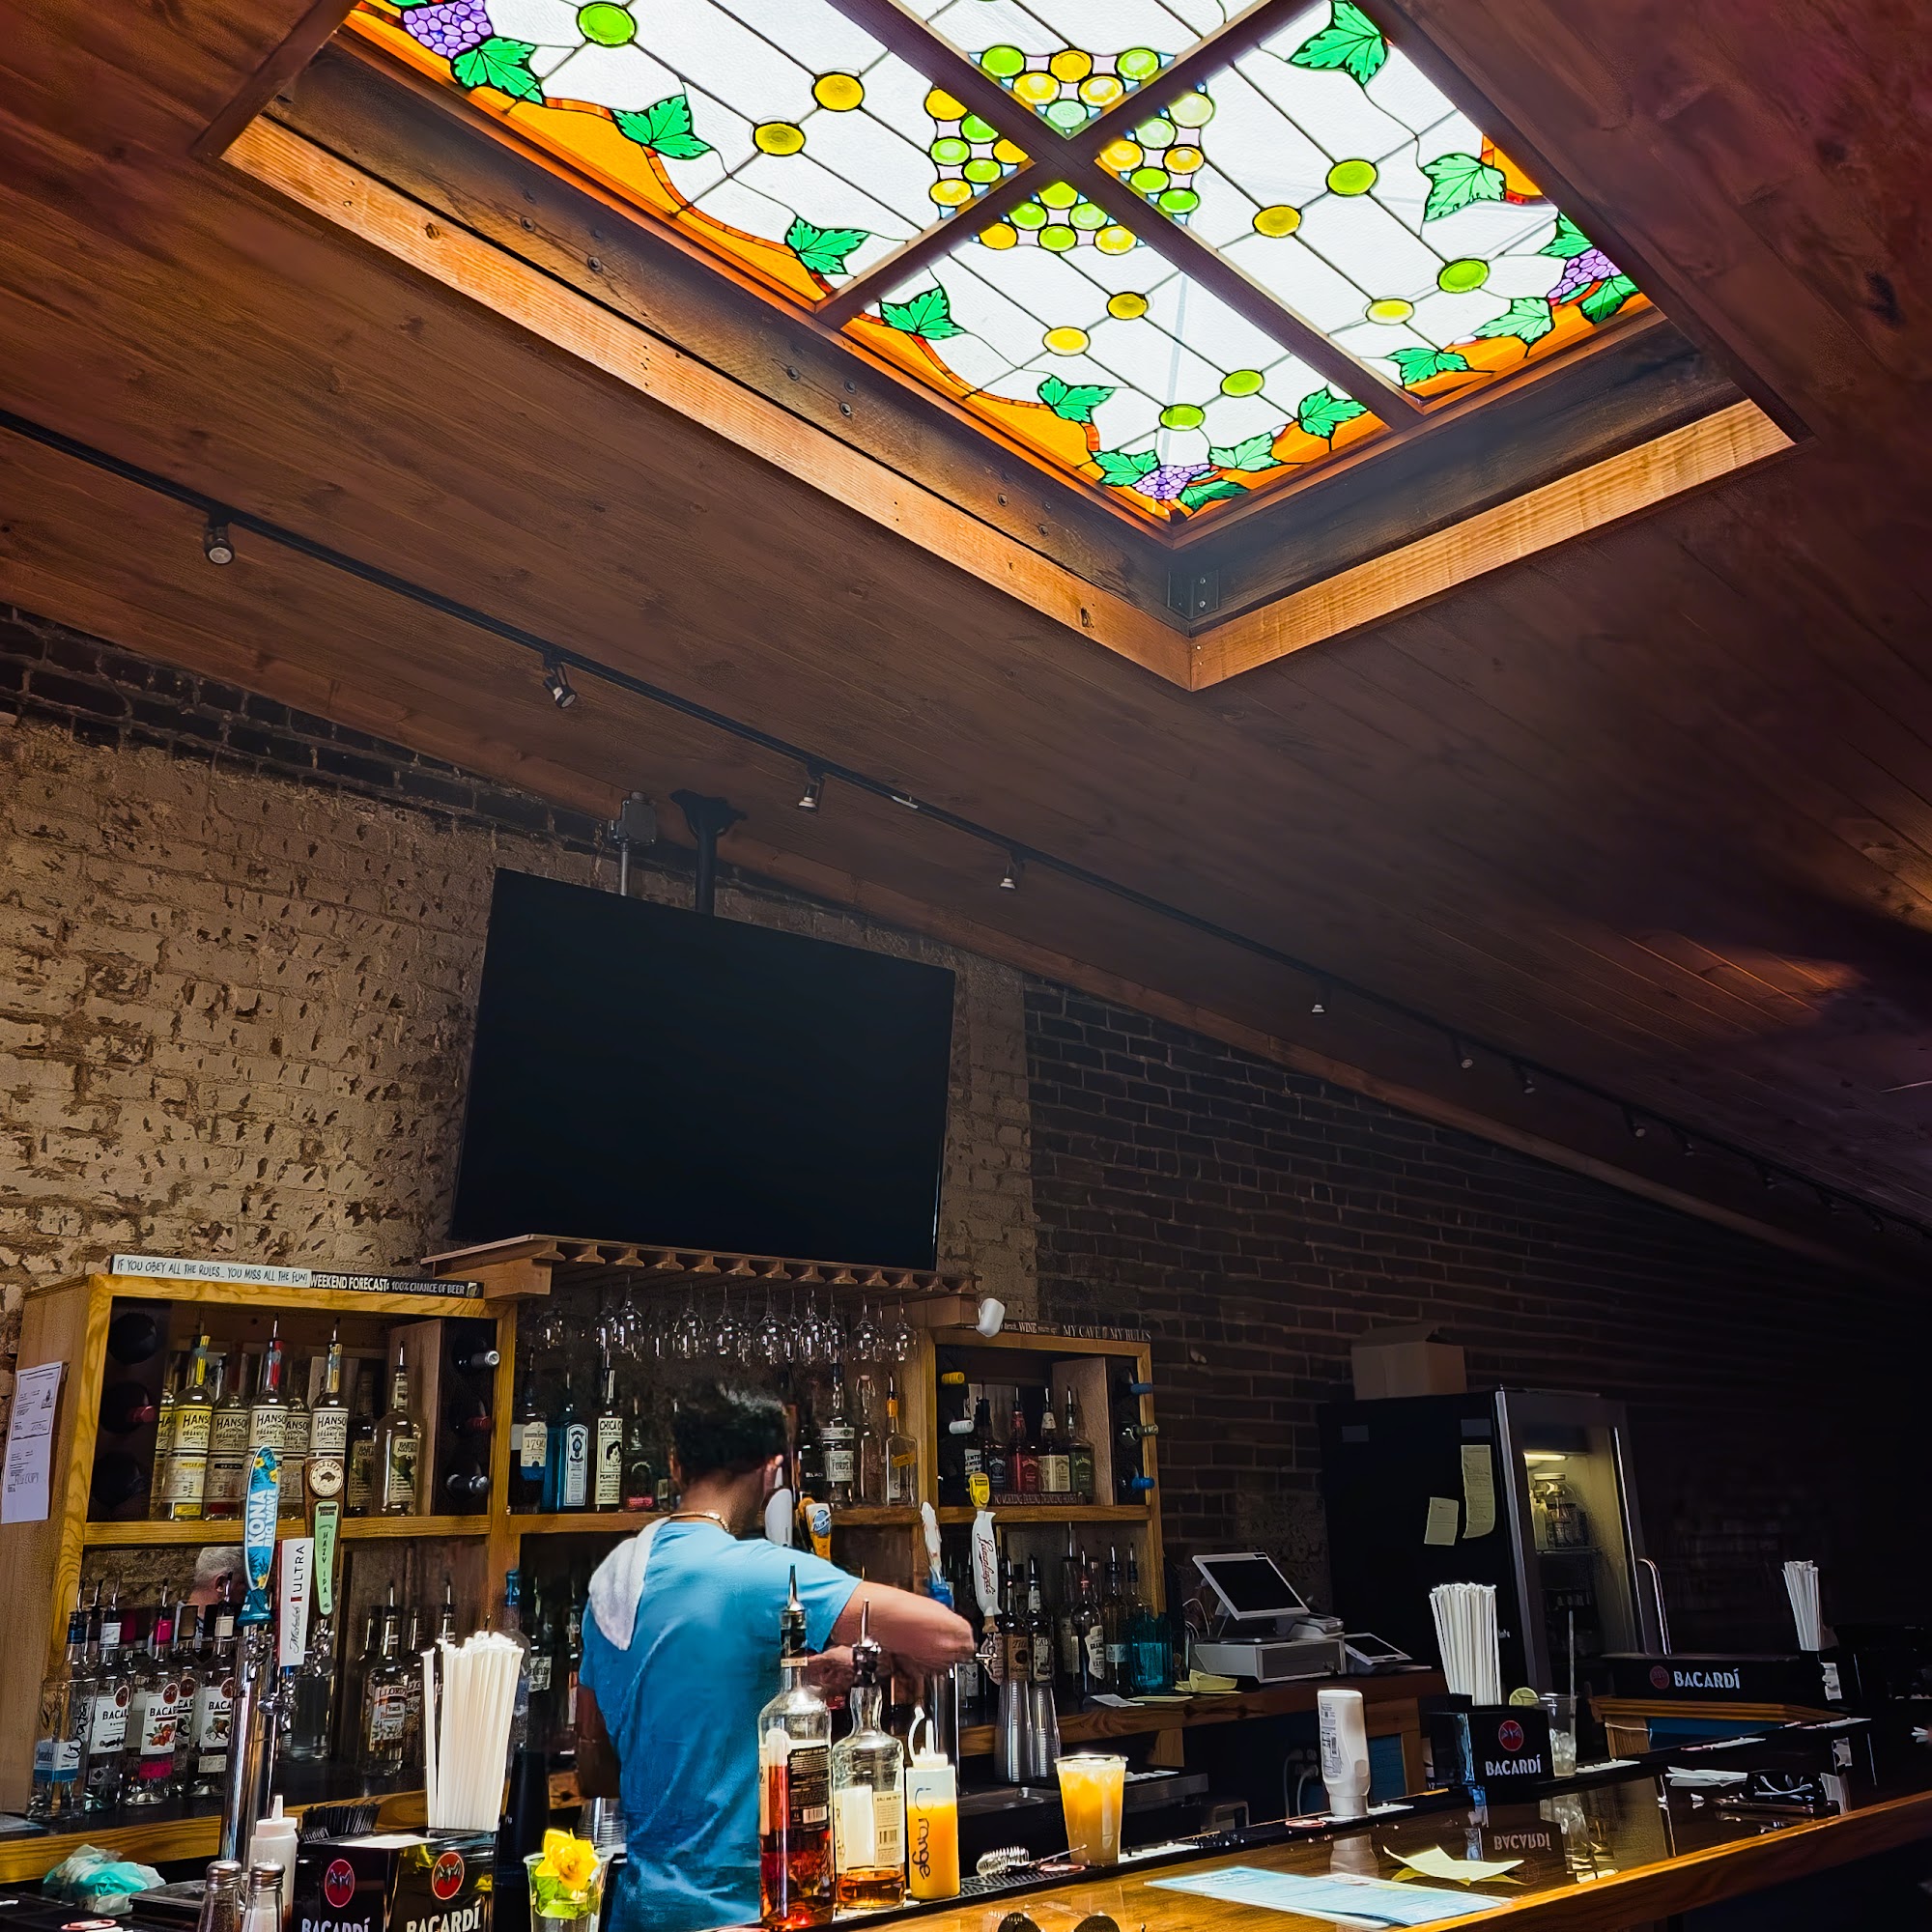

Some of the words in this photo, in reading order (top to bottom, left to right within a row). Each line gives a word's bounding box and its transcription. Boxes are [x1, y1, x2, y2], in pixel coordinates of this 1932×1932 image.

[117, 1259, 124, 1269] IF
[128, 1260, 143, 1271] YOU
[145, 1262, 166, 1274] OBEY
[168, 1263, 181, 1274] ALL
[184, 1264, 197, 1274] THE
[227, 1268, 242, 1279] YOU
[244, 1269, 262, 1280] MISS
[263, 1270, 275, 1282] ALL
[277, 1271, 290, 1282] THE
[310, 1274, 348, 1290] WEEKEND
[349, 1277, 389, 1293] FORECAST:
[391, 1282, 410, 1292] 100%
[410, 1283, 438, 1293] CHANCE
[439, 1284, 446, 1293] OF
[447, 1285, 465, 1294] BEER
[1078, 1325, 1101, 1339] CAVE
[216, 1418, 246, 1431] HANSO
[256, 1414, 286, 1428] HANSO
[317, 1415, 346, 1430] HANSO
[247, 1489, 268, 1548] KONA
[264, 1489, 278, 1529] WAVE
[263, 1529, 272, 1548] BIG
[292, 1545, 305, 1593] ULTRA
[1673, 1668, 1741, 1689] BACARDÍ
[209, 1701, 231, 1710] BACA
[1485, 1754, 1542, 1776] BACARDÍ
